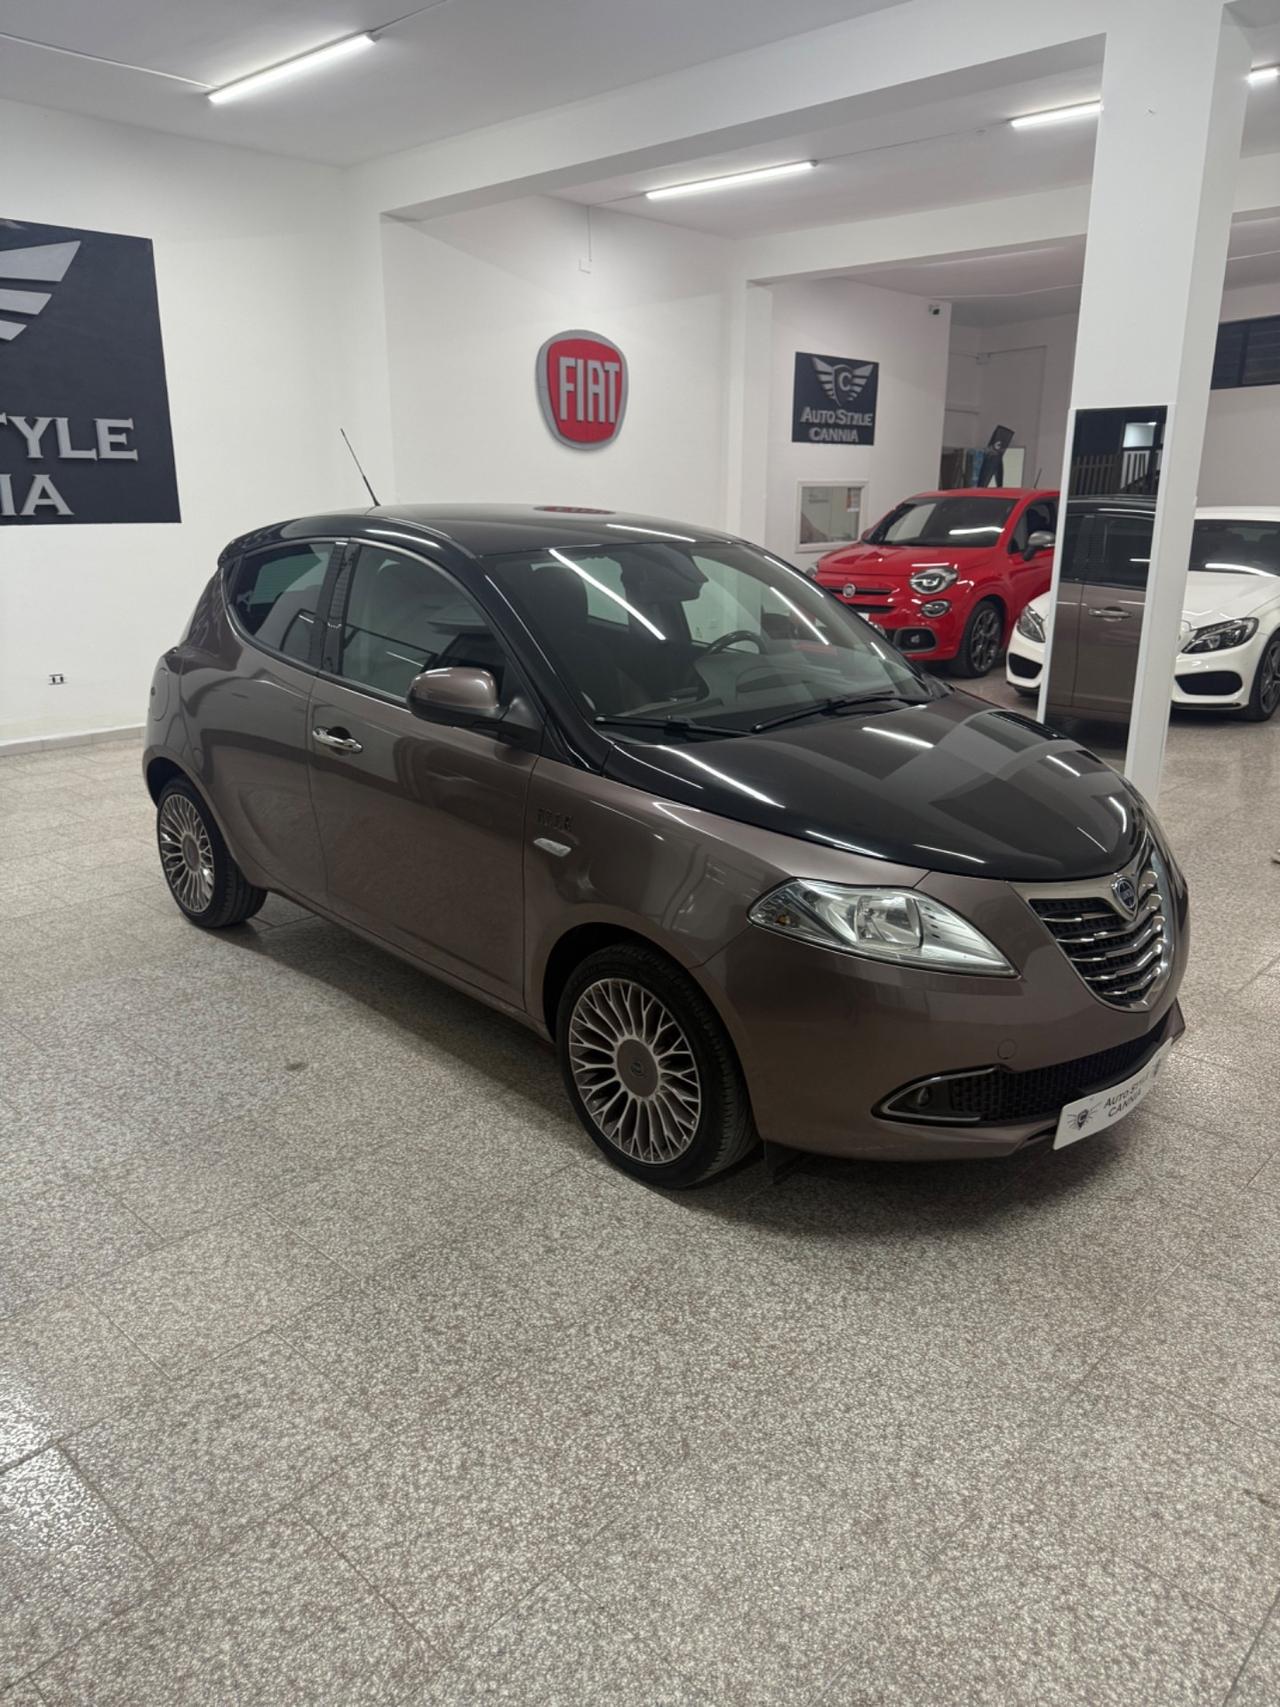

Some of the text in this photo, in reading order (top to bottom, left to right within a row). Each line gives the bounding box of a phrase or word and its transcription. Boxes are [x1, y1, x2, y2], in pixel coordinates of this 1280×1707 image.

[559, 356, 620, 423] FIAT
[800, 406, 873, 426] AUTO STYLE
[0, 412, 138, 461] YLE
[809, 427, 859, 442] CANNIA
